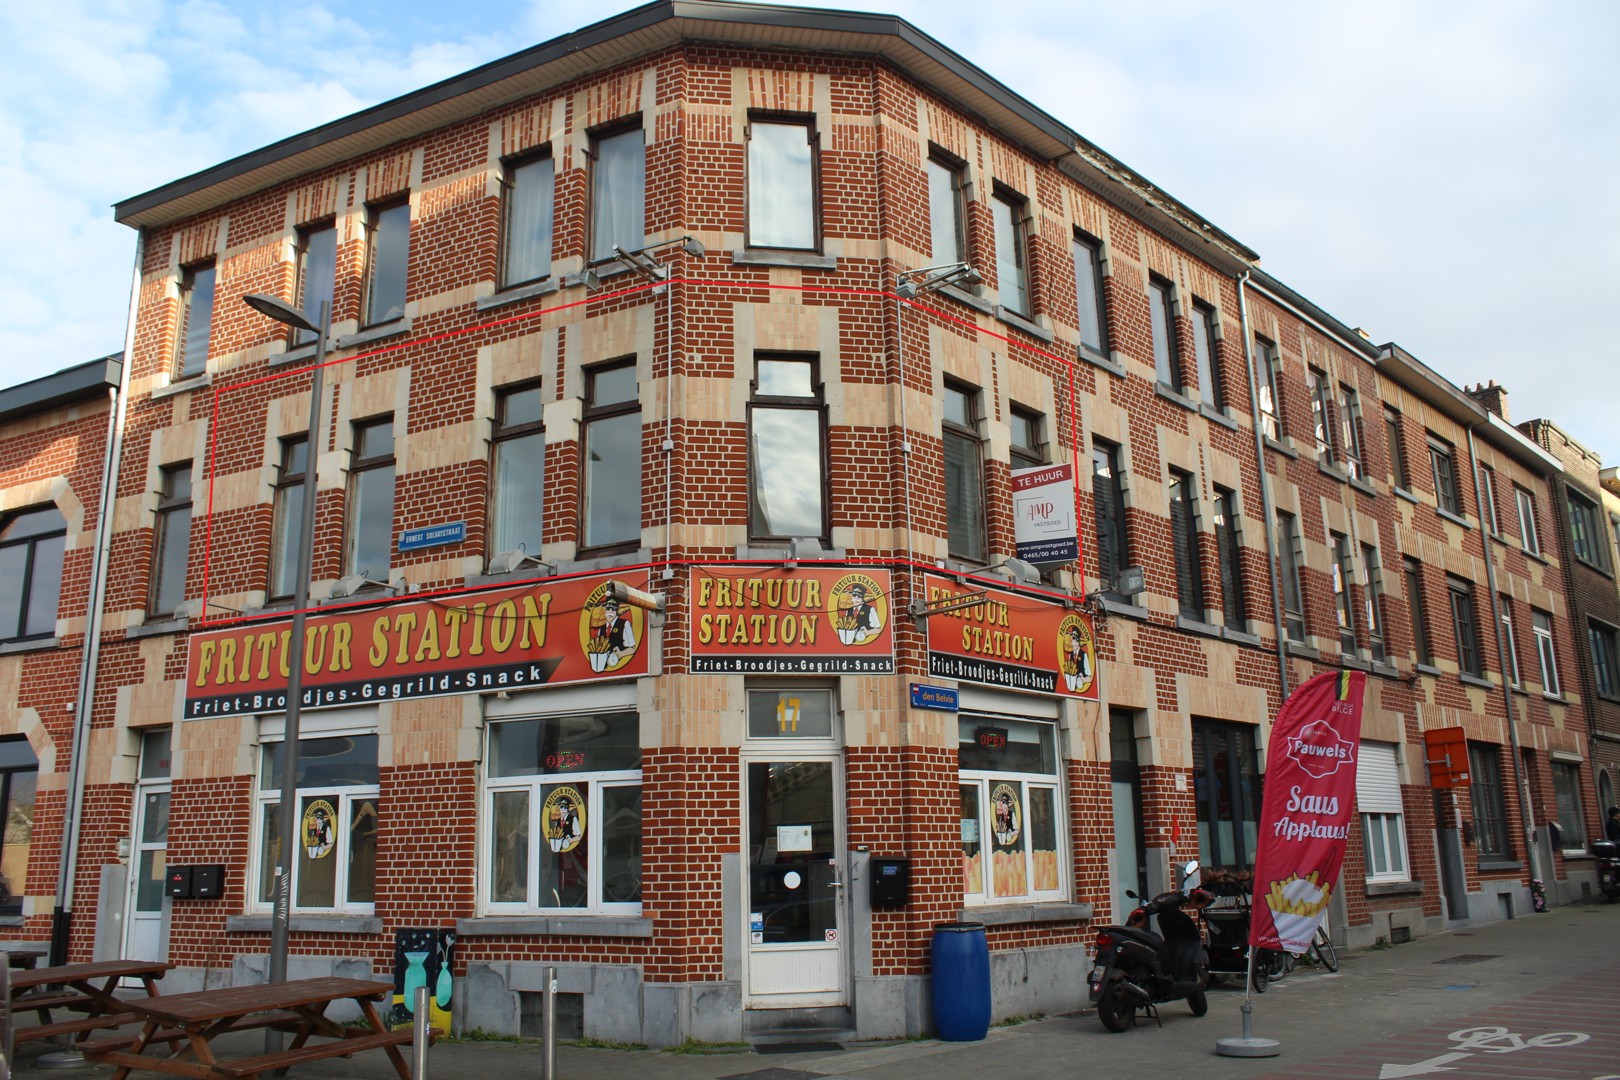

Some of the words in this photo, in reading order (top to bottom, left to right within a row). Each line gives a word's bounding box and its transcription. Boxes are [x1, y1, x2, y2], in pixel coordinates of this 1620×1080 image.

[1018, 478, 1031, 487] TE
[1034, 470, 1064, 484] HUUR
[406, 533, 423, 543] ERNEST
[426, 527, 461, 540] SOLVAYSTRAAT
[698, 577, 823, 609] FRITUUR
[832, 575, 856, 596] FRITUUR
[858, 575, 882, 596] STATION
[369, 593, 552, 667] STATION
[698, 613, 818, 645] STATION
[962, 625, 1034, 662] STATION
[193, 665, 540, 715] Friet-Brodjes-Gegrild-Snack
[777, 697, 801, 732] 17
[980, 734, 1006, 747] OPEN
[1294, 740, 1347, 758] Pauwels
[545, 754, 585, 768] OPEN
[1286, 785, 1339, 815] Saus
[1274, 816, 1351, 842] Applaus!
